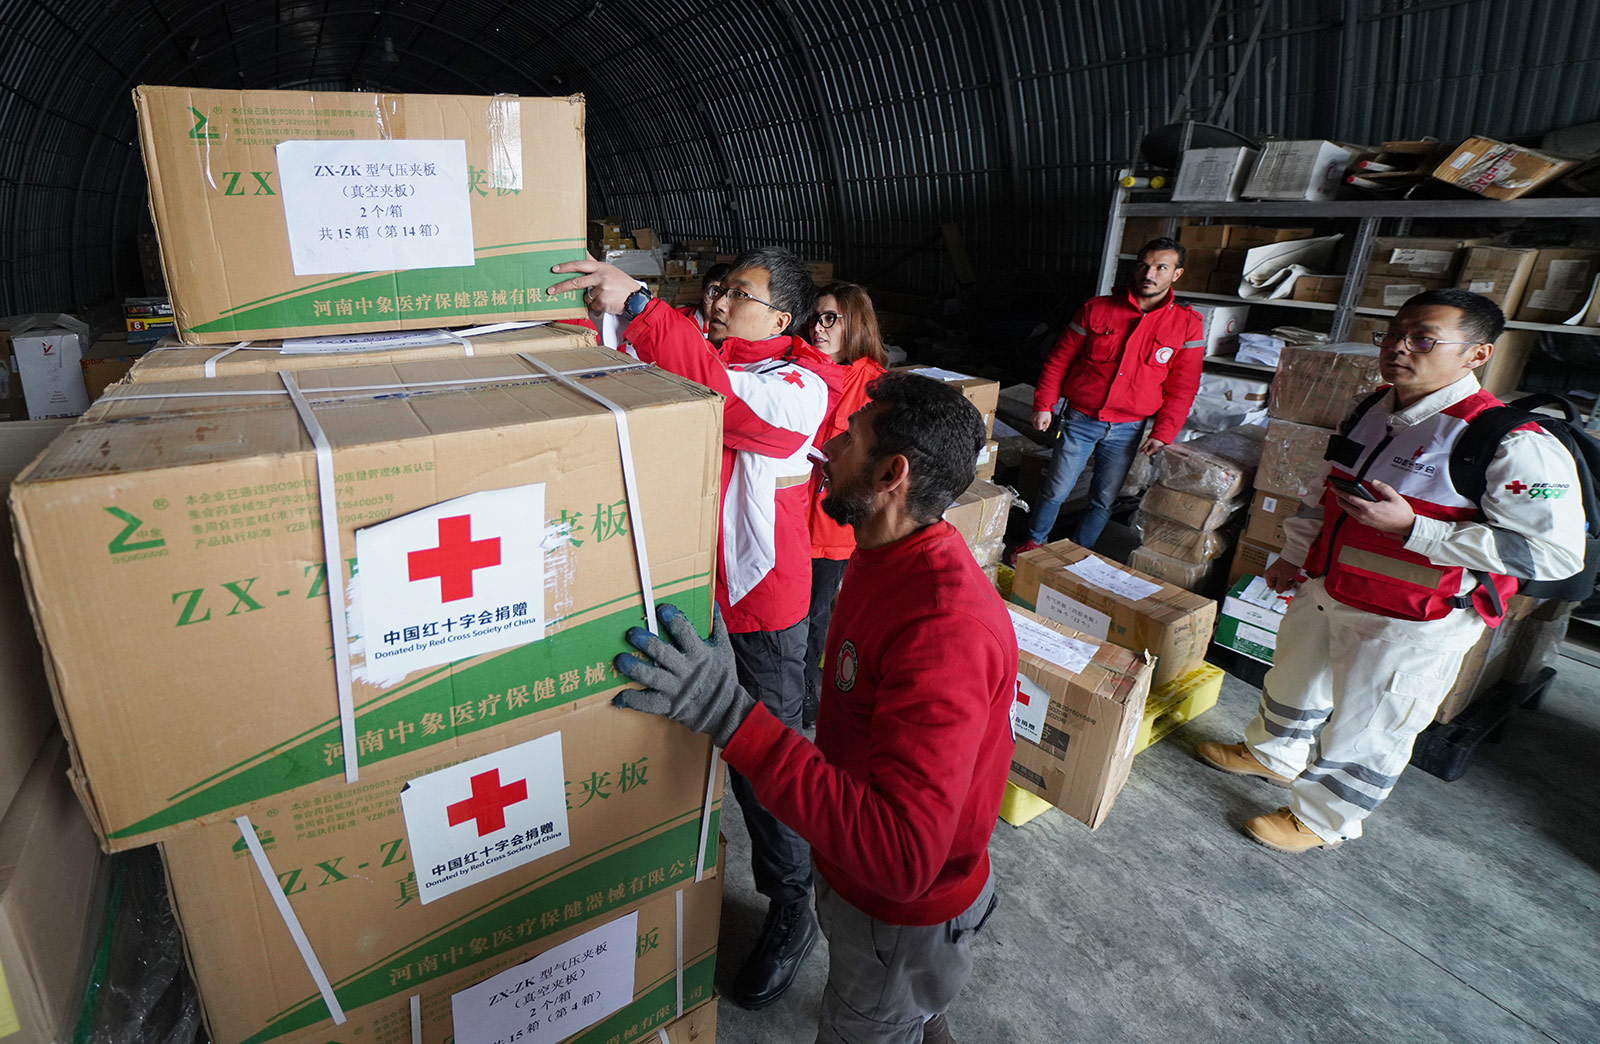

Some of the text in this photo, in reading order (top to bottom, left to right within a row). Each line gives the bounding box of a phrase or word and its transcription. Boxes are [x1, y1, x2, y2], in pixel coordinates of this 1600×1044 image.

[314, 163, 437, 177] ZX-ZK 型气压夹板
[342, 184, 416, 198] （真空夹板）
[360, 204, 403, 218] 2 个/箱
[319, 227, 333, 241] 共
[338, 229, 352, 239] 15
[402, 226, 416, 237] 14
[374, 617, 536, 660] Donated by Red Cross Society of China
[383, 601, 528, 646] 中国红十字会捐赠
[425, 832, 562, 889] Donated by Red Cross Society of China
[431, 821, 554, 877] 中国红十字会捐赠
[488, 941, 608, 1007] ZX-ZK 型气压夹板
[514, 968, 586, 1009] （真空夹板）
[529, 990, 572, 1018] 2 个/箱
[510, 1030, 523, 1043] 15
